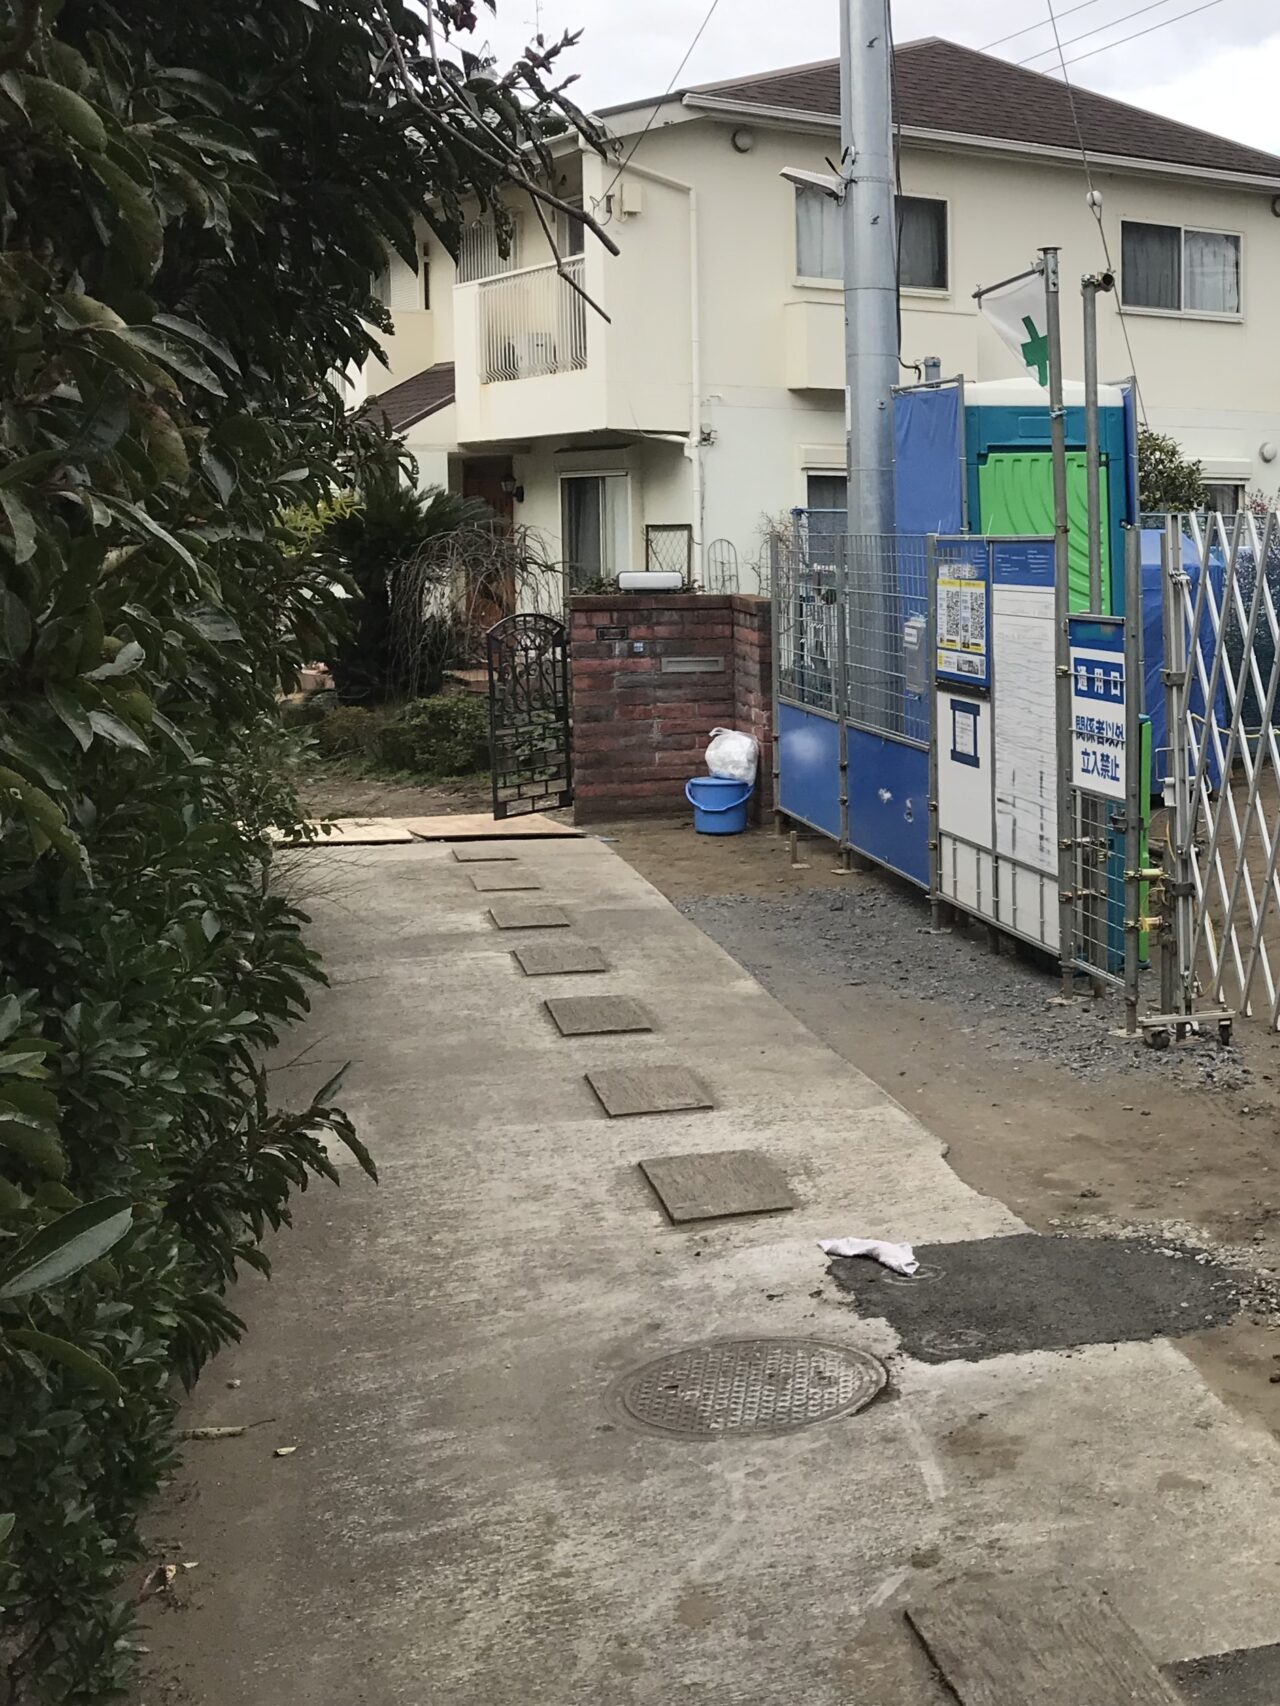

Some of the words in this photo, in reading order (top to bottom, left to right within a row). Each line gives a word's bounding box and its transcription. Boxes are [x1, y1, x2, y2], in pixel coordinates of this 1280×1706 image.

[1077, 666, 1120, 696] 通用口
[1075, 715, 1125, 750] 関係者以外
[1081, 748, 1120, 782] 立入禁止
